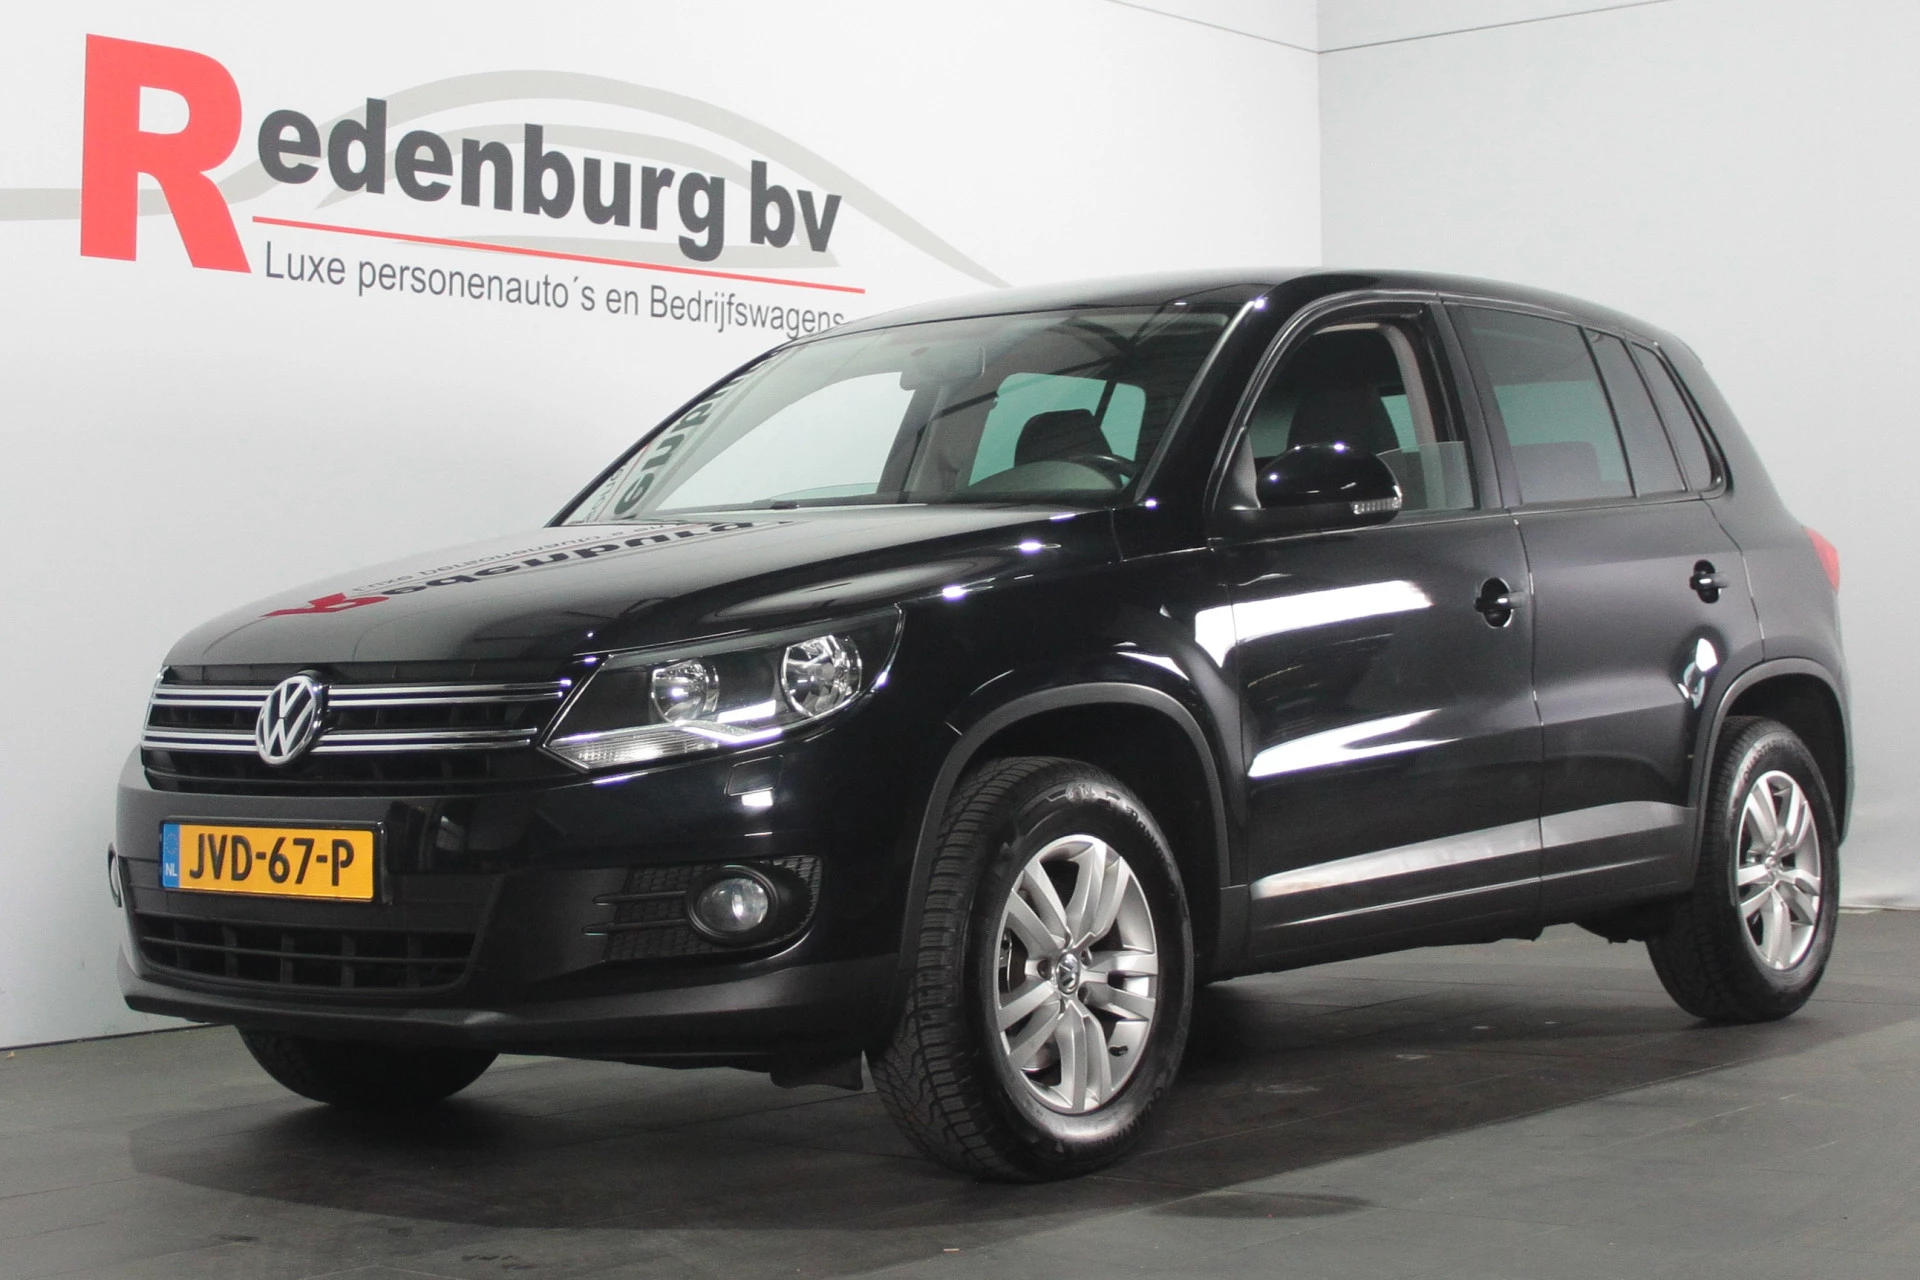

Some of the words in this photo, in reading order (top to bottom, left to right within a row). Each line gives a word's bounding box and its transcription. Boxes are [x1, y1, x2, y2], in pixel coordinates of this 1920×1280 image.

[80, 33, 725, 273] Redenburg
[750, 159, 842, 253] bv
[266, 241, 345, 285] Luxe
[606, 289, 639, 316] en
[650, 284, 845, 339] Bedrijfswagens
[165, 862, 179, 878] NL
[189, 832, 355, 887] JVD-67-P
